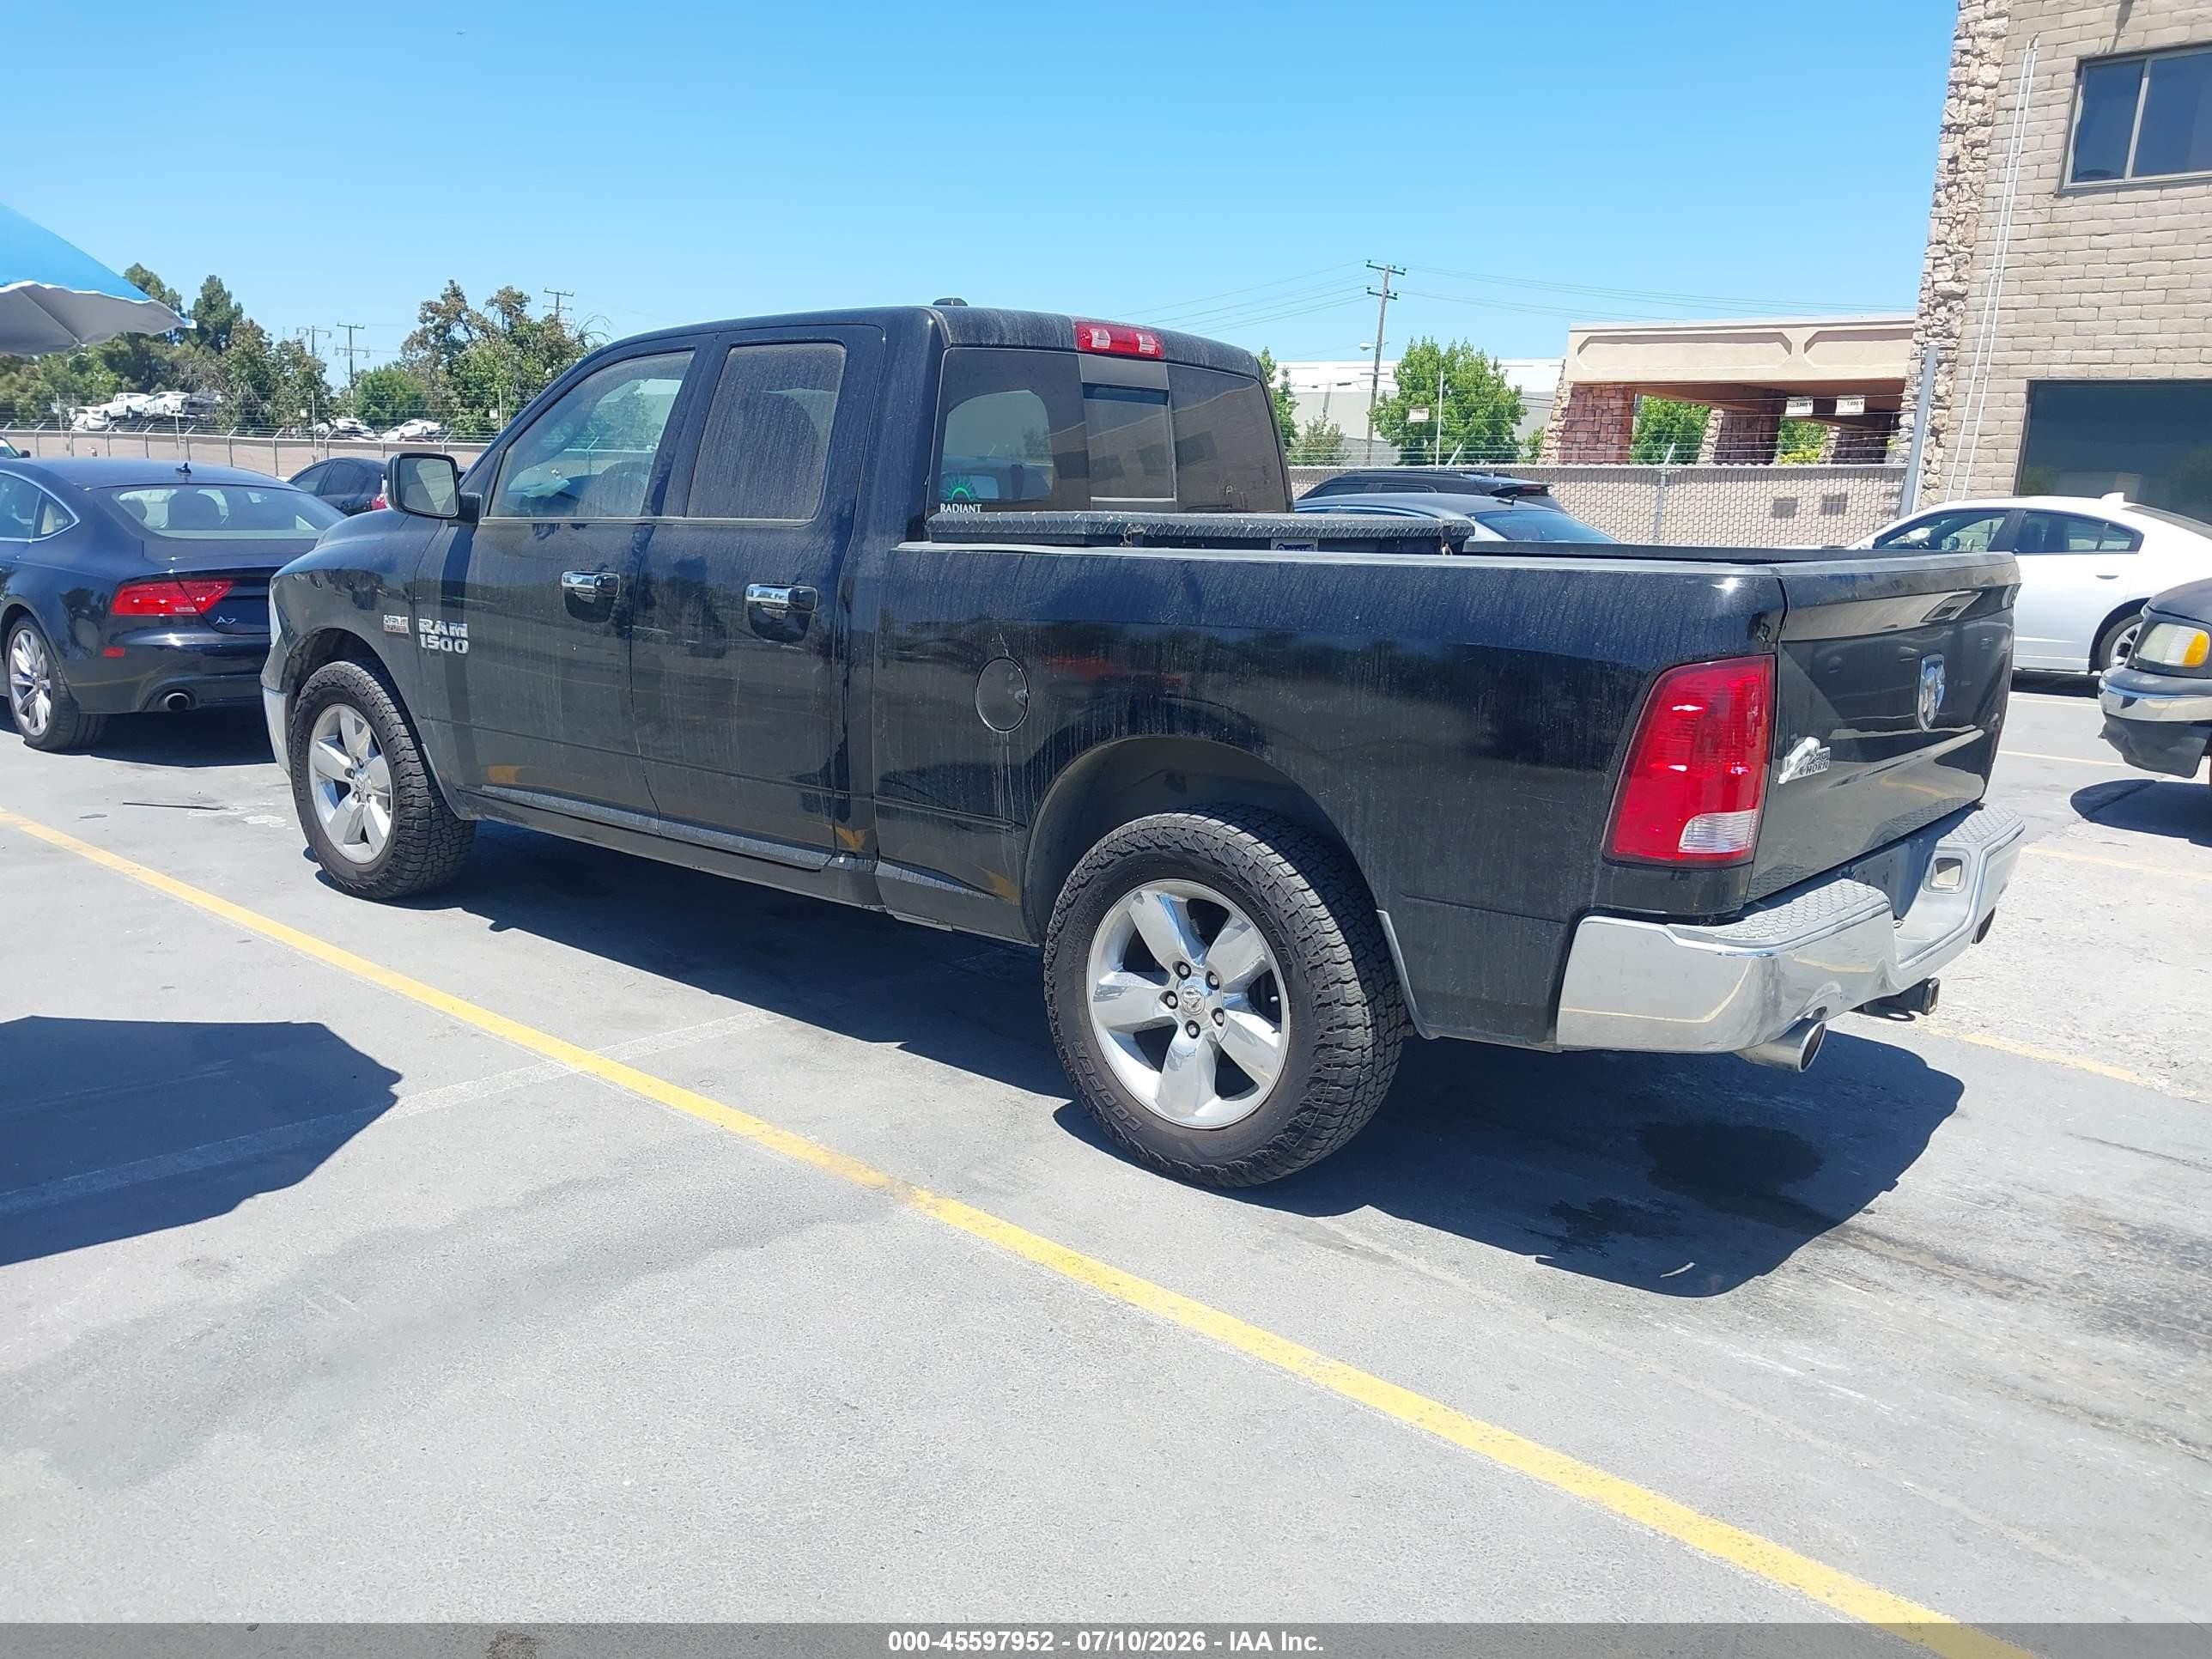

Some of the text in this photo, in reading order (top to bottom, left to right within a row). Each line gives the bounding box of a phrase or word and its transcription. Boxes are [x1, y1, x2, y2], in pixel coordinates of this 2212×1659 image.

[940, 503, 982, 514] RADIANT
[216, 616, 236, 624] A7
[418, 618, 469, 638] RAM
[420, 634, 470, 654] 1500
[1806, 761, 1829, 775] HORN
[1072, 1041, 1142, 1132] COOPER
